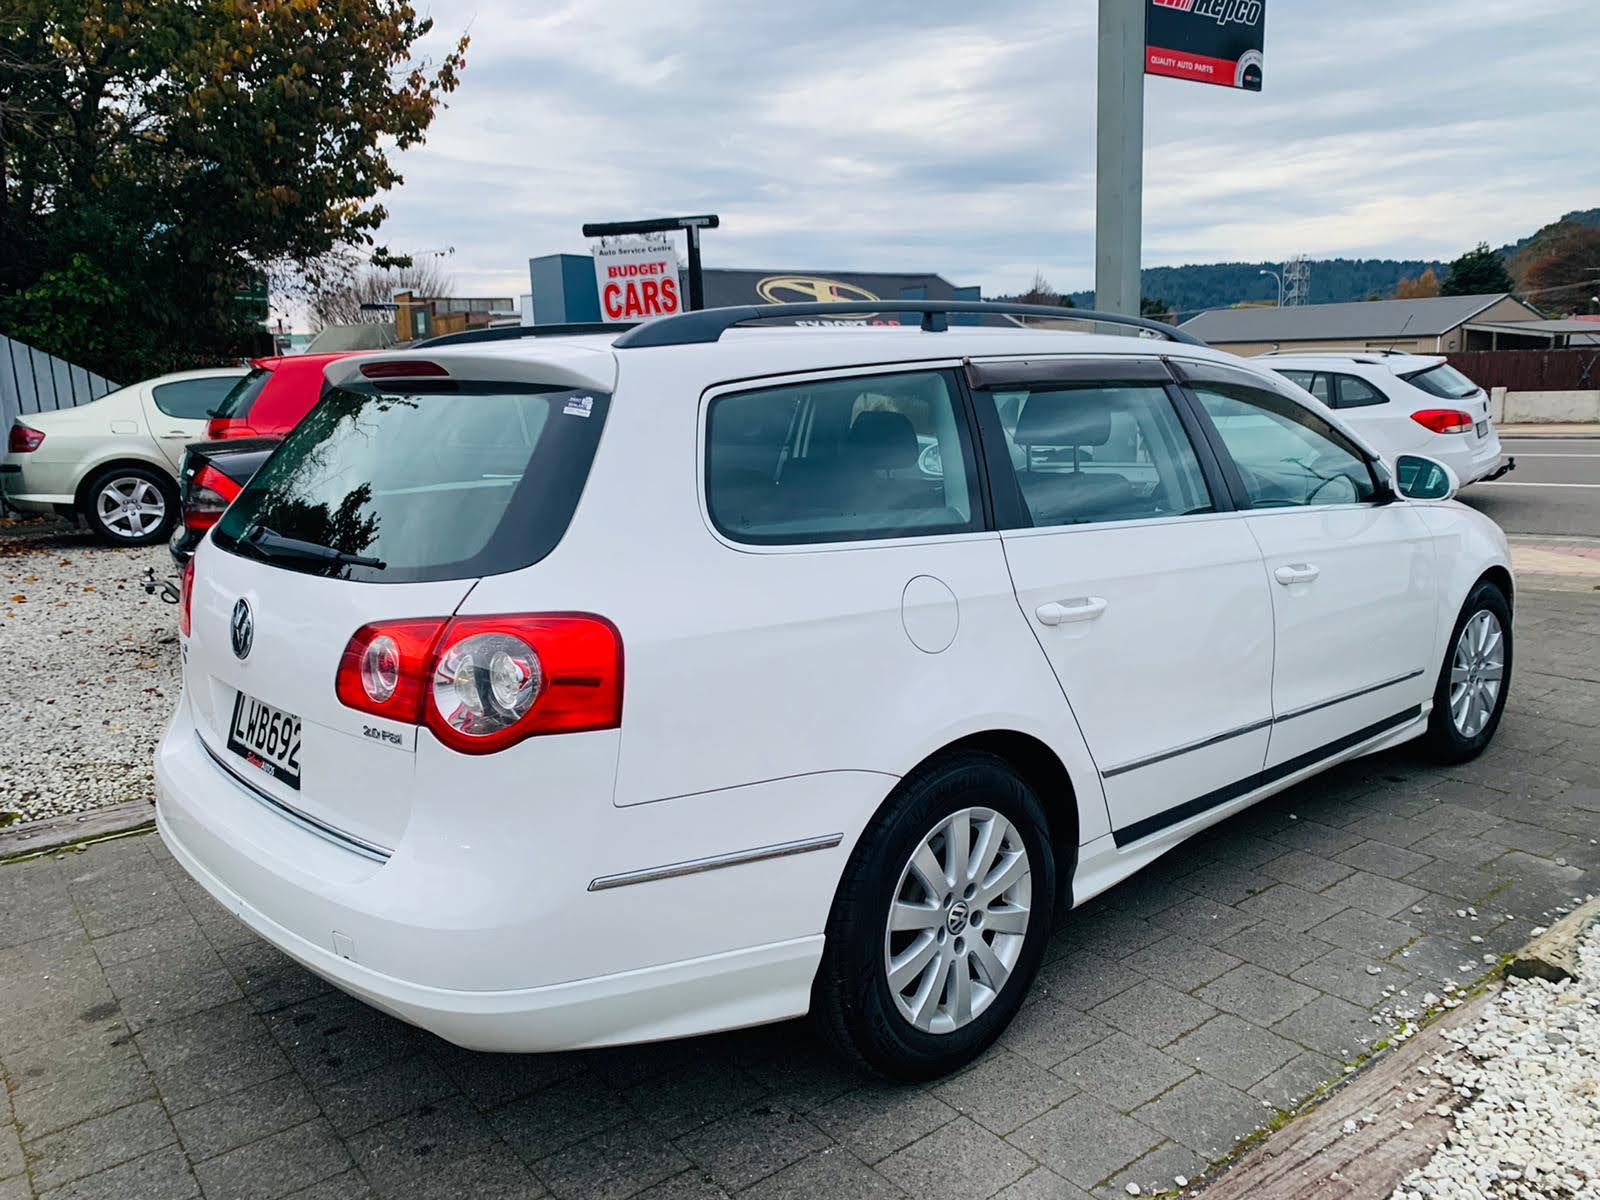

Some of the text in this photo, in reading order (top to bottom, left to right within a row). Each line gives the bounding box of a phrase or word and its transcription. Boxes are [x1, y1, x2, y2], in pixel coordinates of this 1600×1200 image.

[1150, 55, 1214, 74] QUALITY AUTO PARTS
[619, 247, 646, 255] Service
[648, 245, 672, 253] Centre
[607, 261, 667, 278] BUDGET
[603, 277, 679, 320] CARS
[235, 695, 301, 770] LWB692
